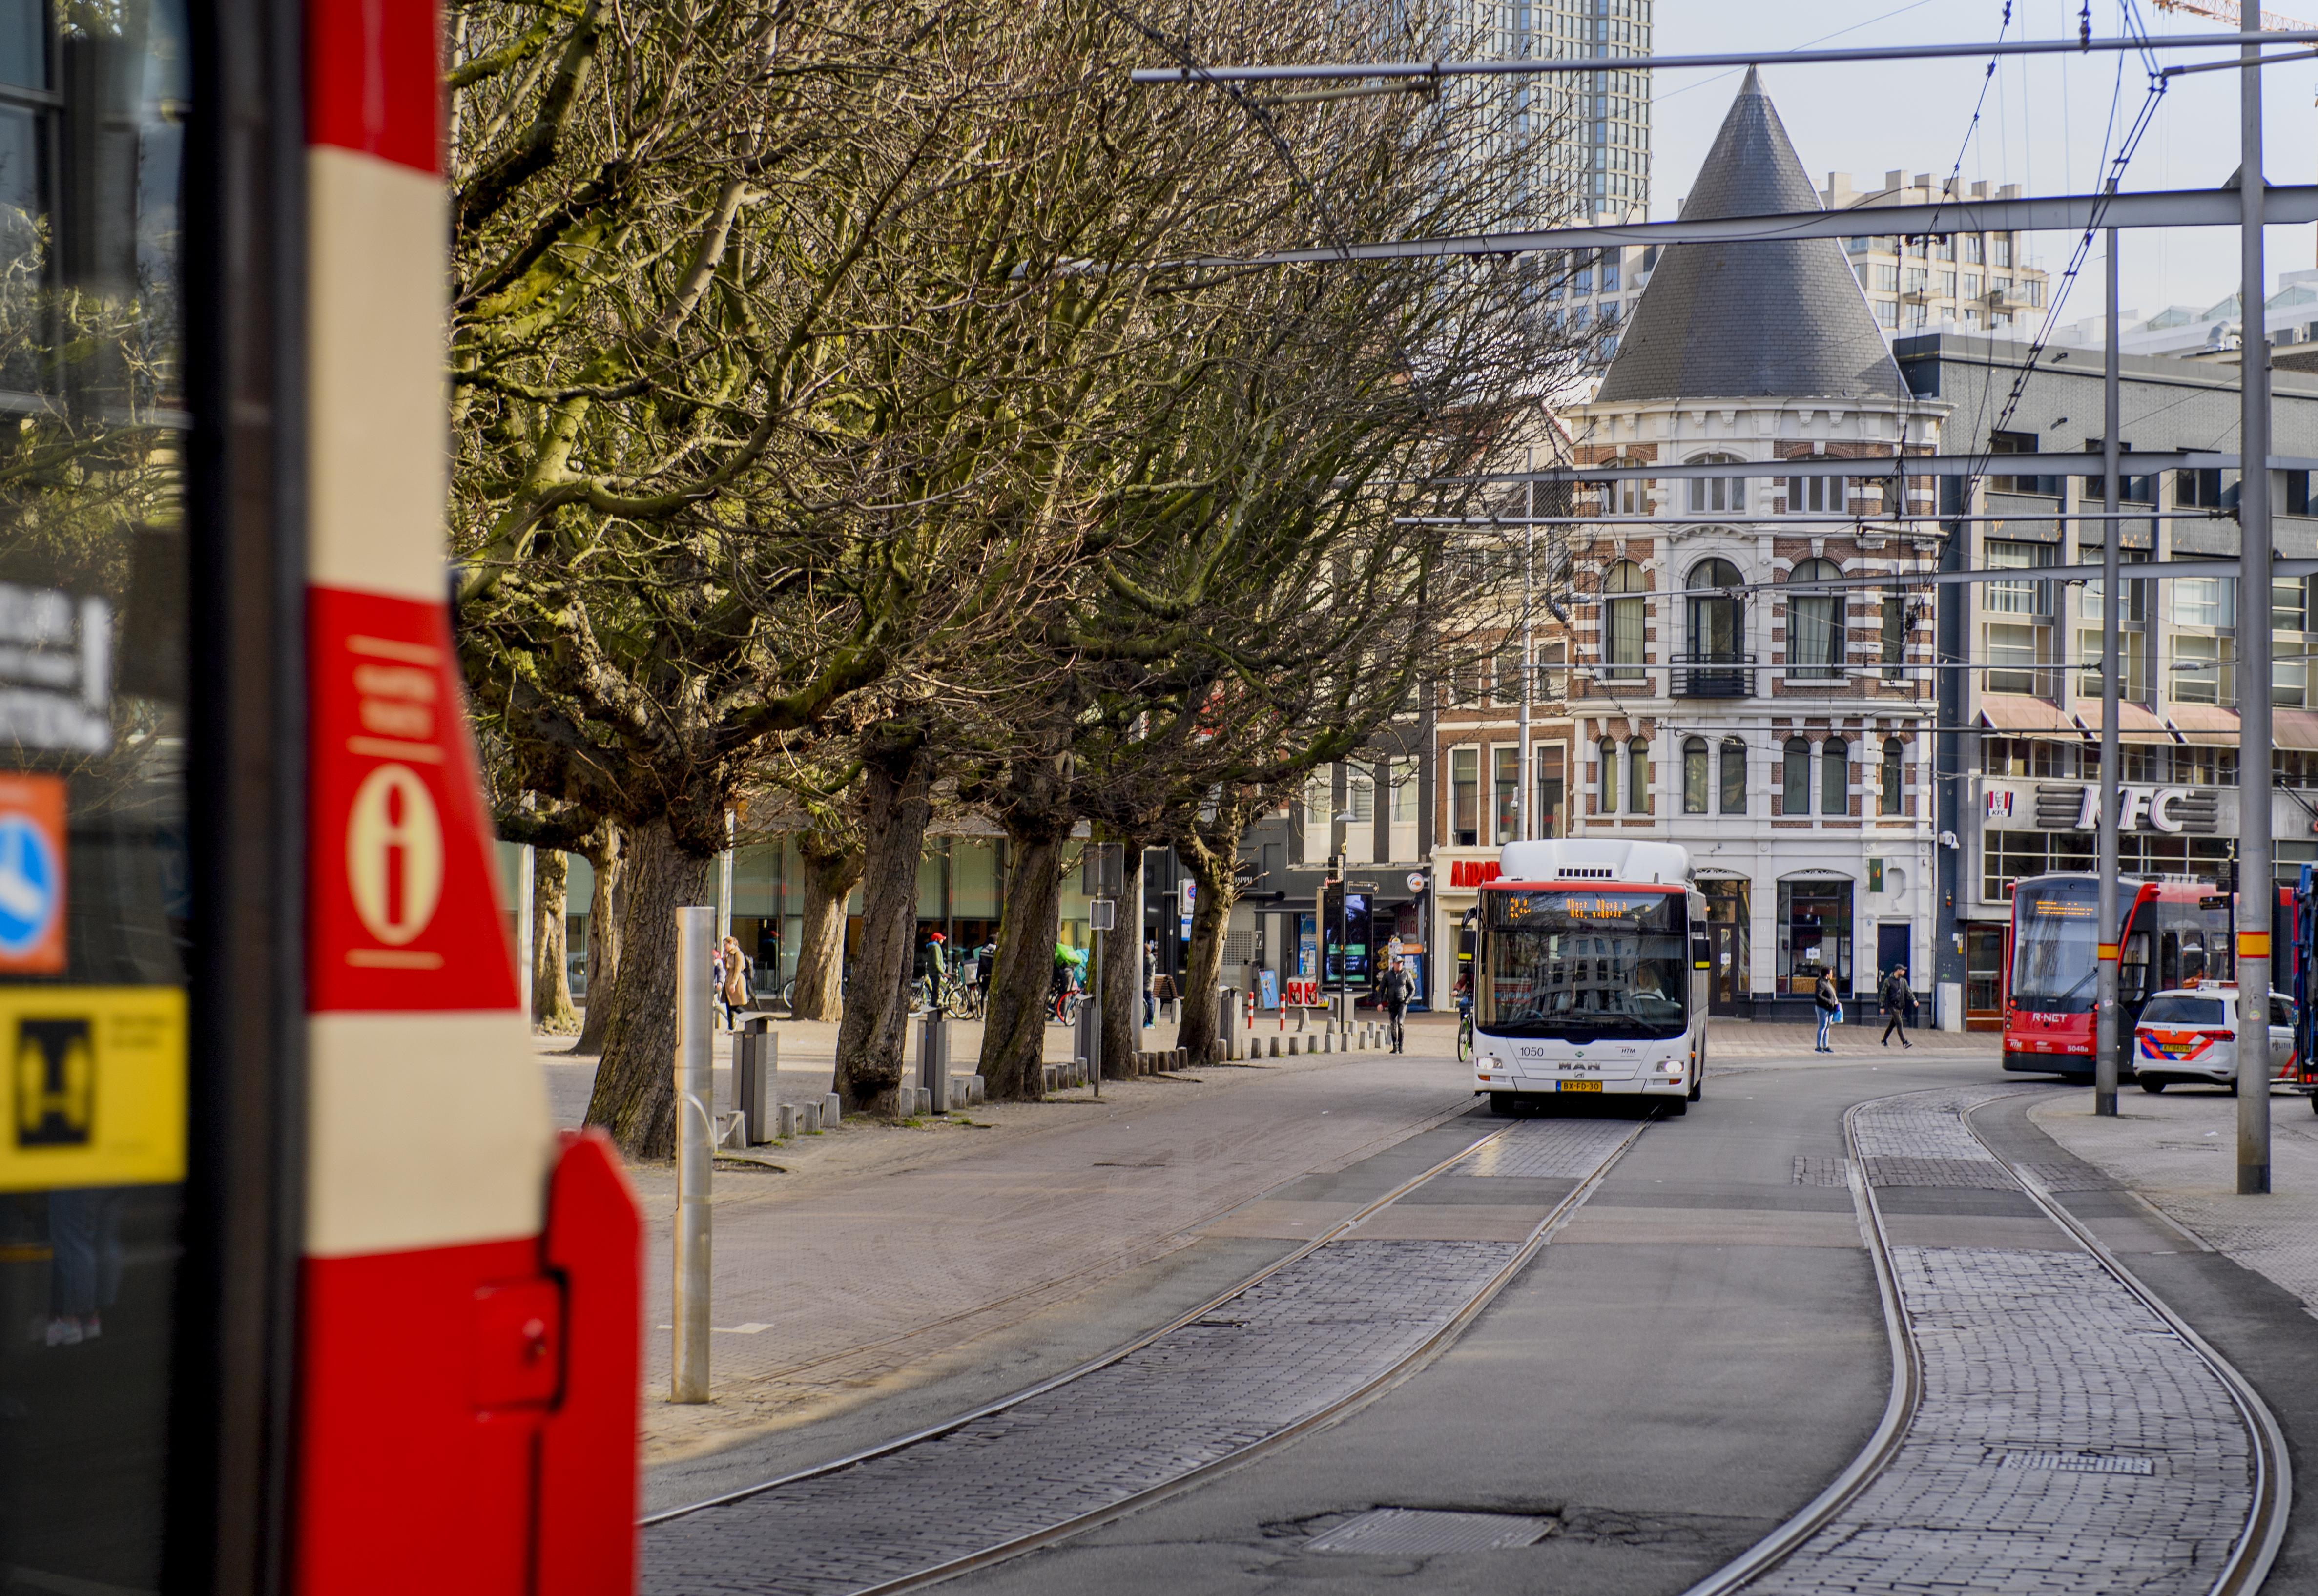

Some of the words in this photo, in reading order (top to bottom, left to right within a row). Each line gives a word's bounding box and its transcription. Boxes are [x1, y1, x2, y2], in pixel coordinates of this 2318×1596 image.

[2075, 784, 2187, 832] KFC
[1519, 1046, 1544, 1057] 1050
[1558, 1061, 1601, 1070] MAN
[1563, 1081, 1600, 1090] BX-FD-30
